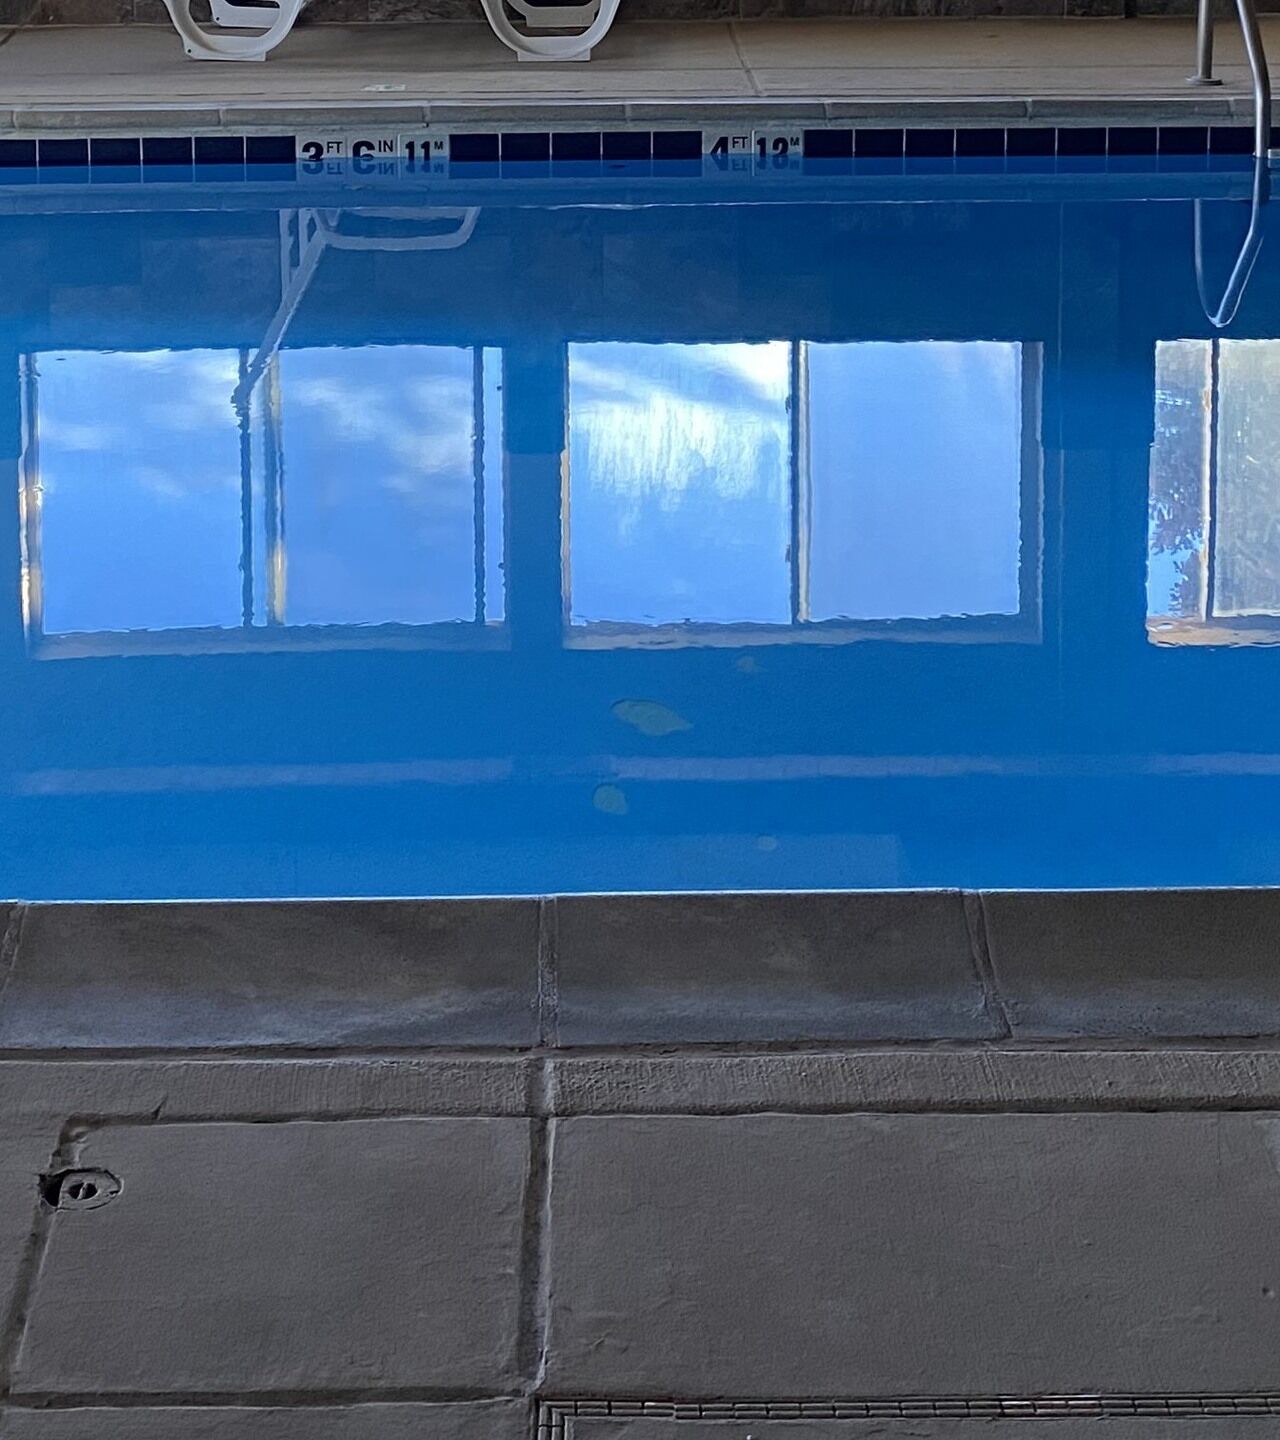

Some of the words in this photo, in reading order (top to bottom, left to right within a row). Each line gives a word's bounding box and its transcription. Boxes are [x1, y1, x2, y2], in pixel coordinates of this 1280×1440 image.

[302, 141, 324, 162] 3
[326, 140, 343, 154] FT
[378, 139, 394, 153] IN
[434, 140, 444, 150] M
[710, 136, 729, 155] 4
[732, 136, 749, 149] FT
[790, 137, 800, 147] M
